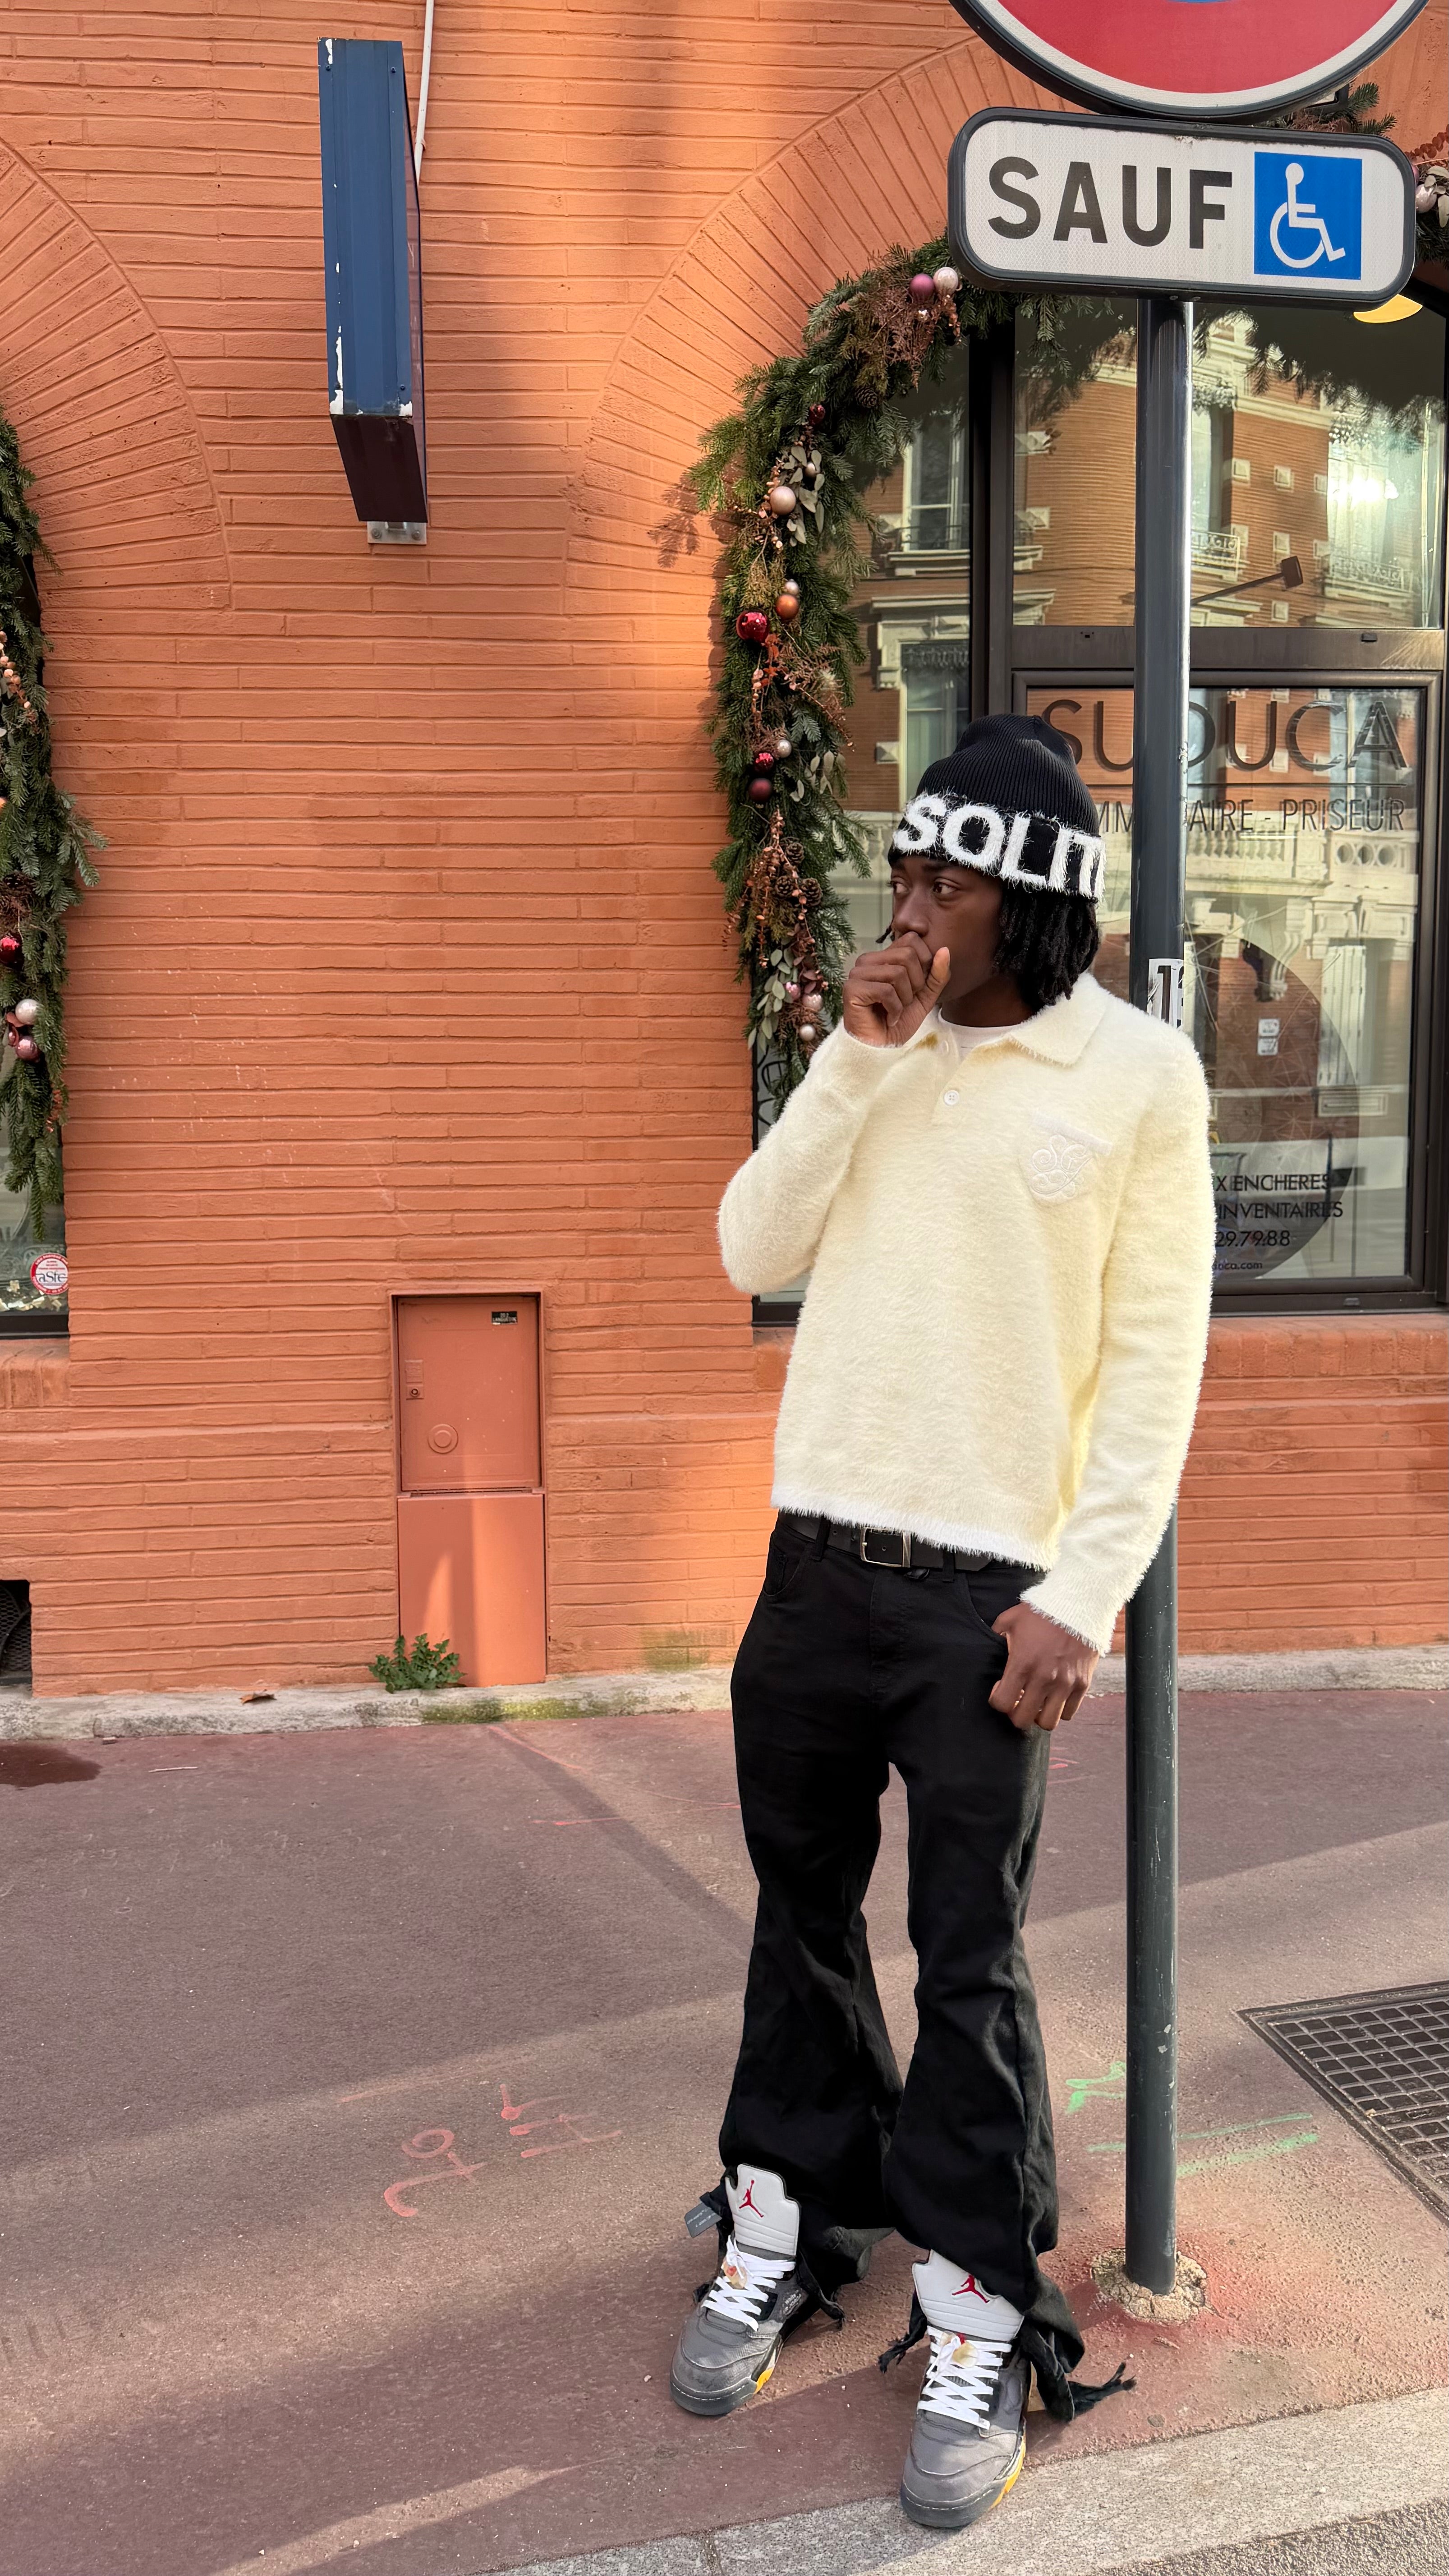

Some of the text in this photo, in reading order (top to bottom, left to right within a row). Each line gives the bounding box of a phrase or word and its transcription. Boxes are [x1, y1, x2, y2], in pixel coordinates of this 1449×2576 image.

[988, 156, 1233, 249] SAUF
[1283, 798, 1405, 831] PRISEUR
[1233, 1173, 1331, 1191] ENCHERES
[1219, 1201, 1343, 1219] INVENTAIRES
[1215, 1230, 1290, 1247] 29.79.88
